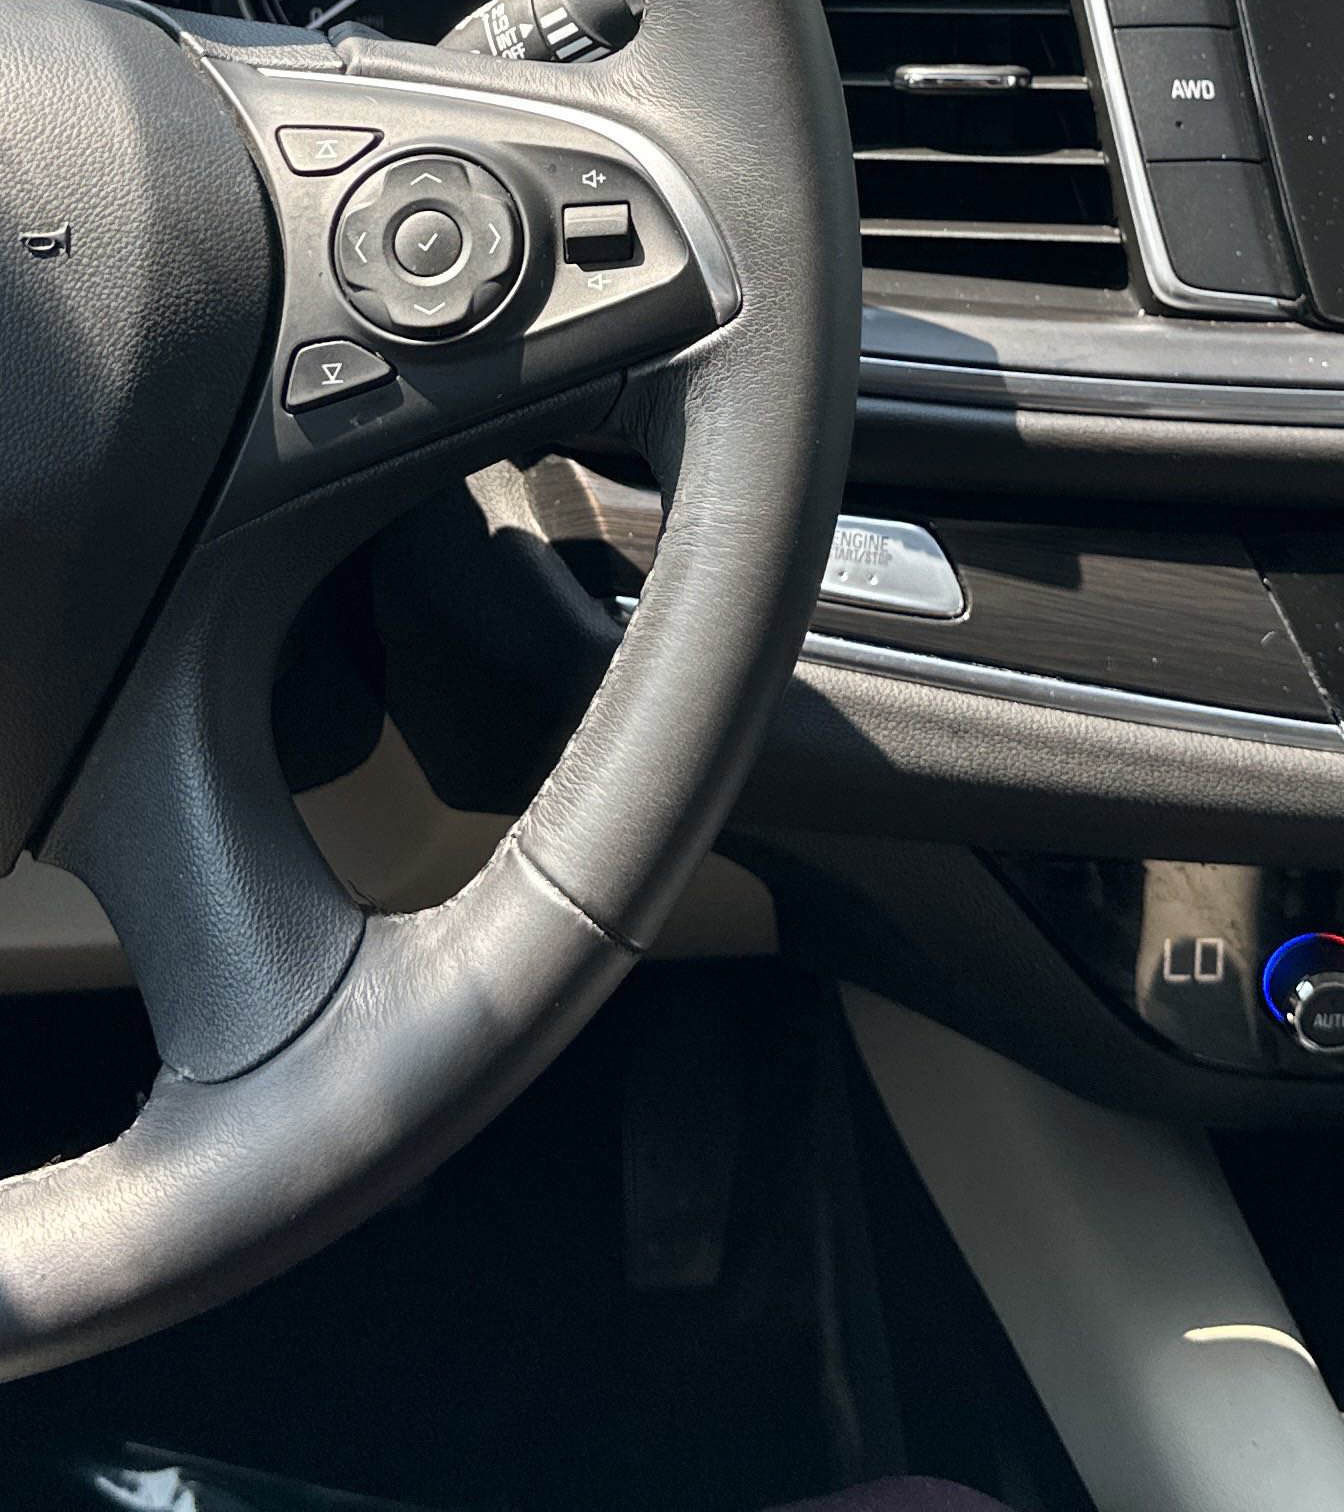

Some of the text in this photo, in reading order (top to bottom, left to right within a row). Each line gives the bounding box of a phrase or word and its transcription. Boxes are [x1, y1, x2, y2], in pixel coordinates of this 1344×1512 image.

[492, 3, 504, 20] HI
[493, 15, 509, 35] LO
[496, 27, 518, 51] INT
[1171, 80, 1215, 100] AWD
[832, 546, 893, 565] TART/STOP
[1164, 938, 1223, 982] LO
